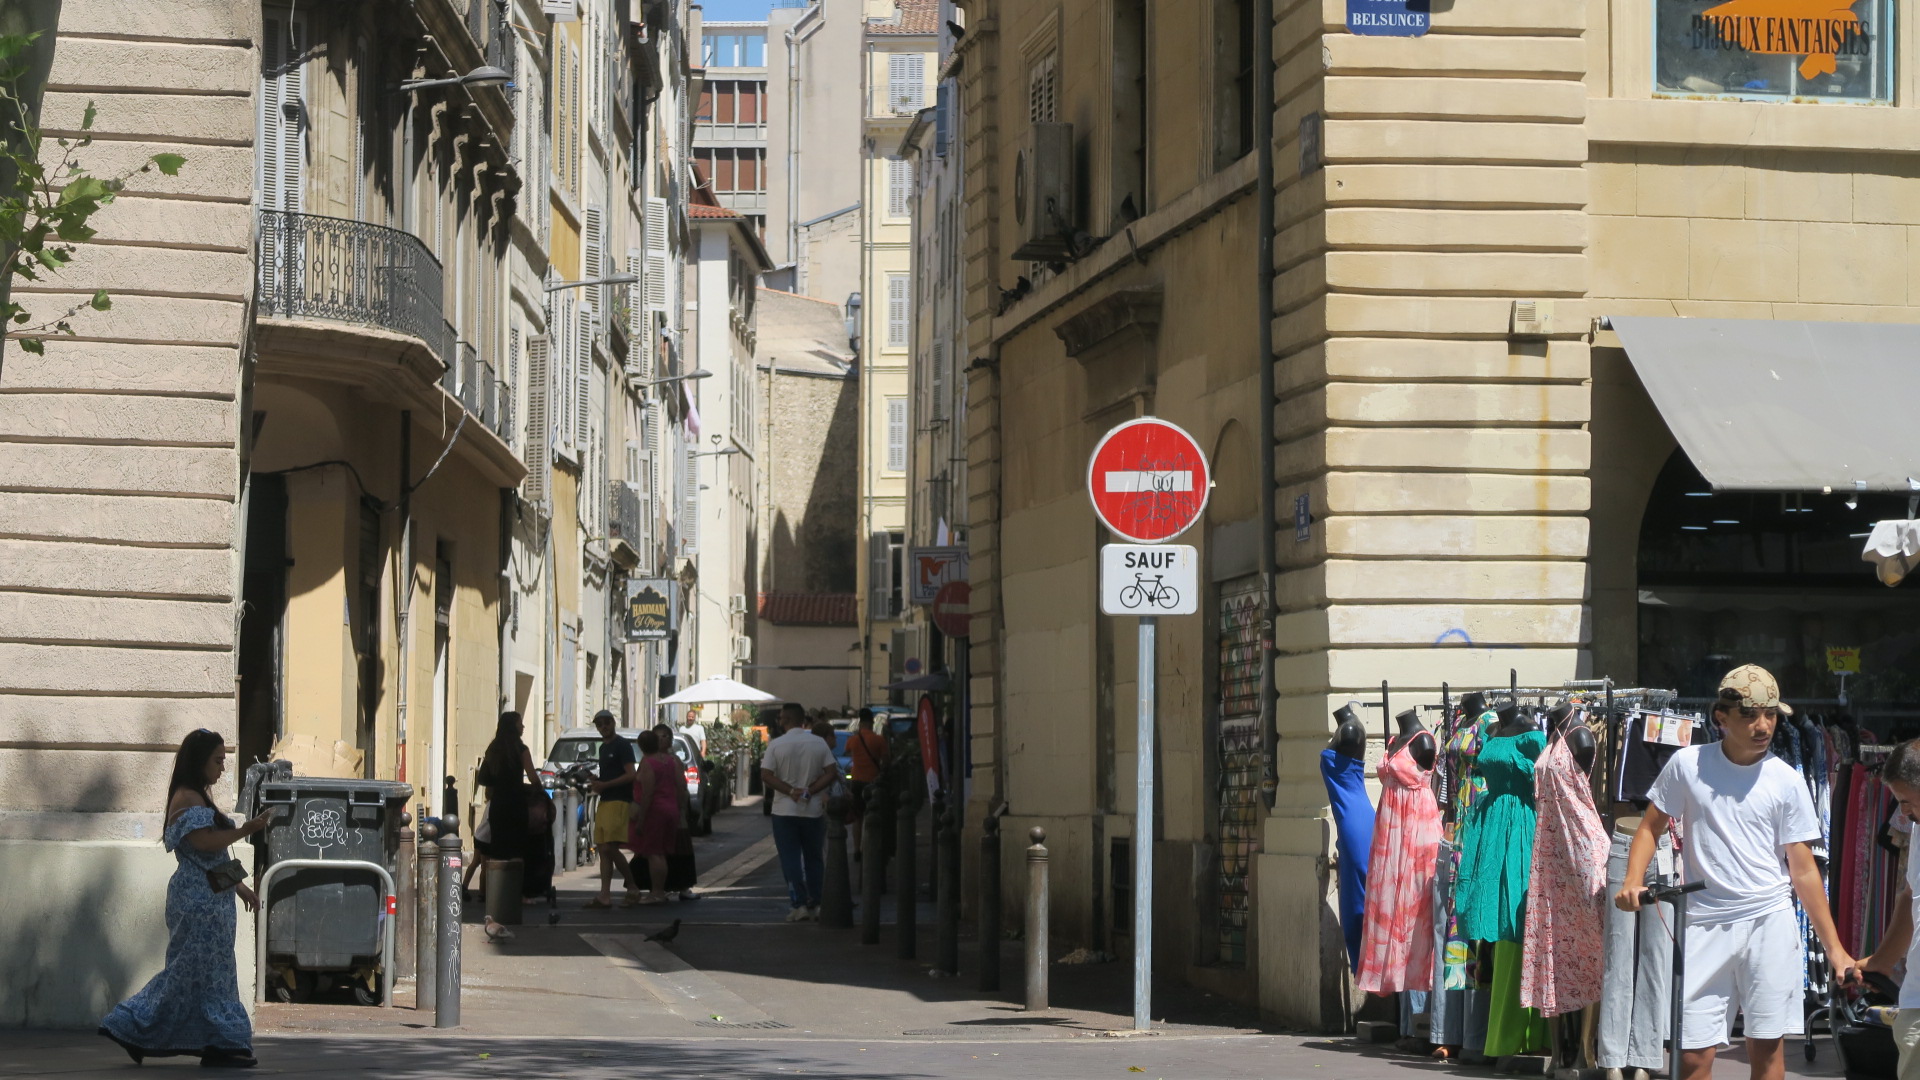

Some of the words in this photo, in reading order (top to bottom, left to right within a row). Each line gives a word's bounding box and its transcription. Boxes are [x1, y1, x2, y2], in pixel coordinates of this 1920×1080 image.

[1352, 12, 1425, 27] BELSUNCE
[1691, 14, 1761, 52] BIJOUX
[1766, 17, 1870, 56] FANTAISIES
[1124, 552, 1176, 569] SAUF
[632, 603, 667, 618] HAMMAM
